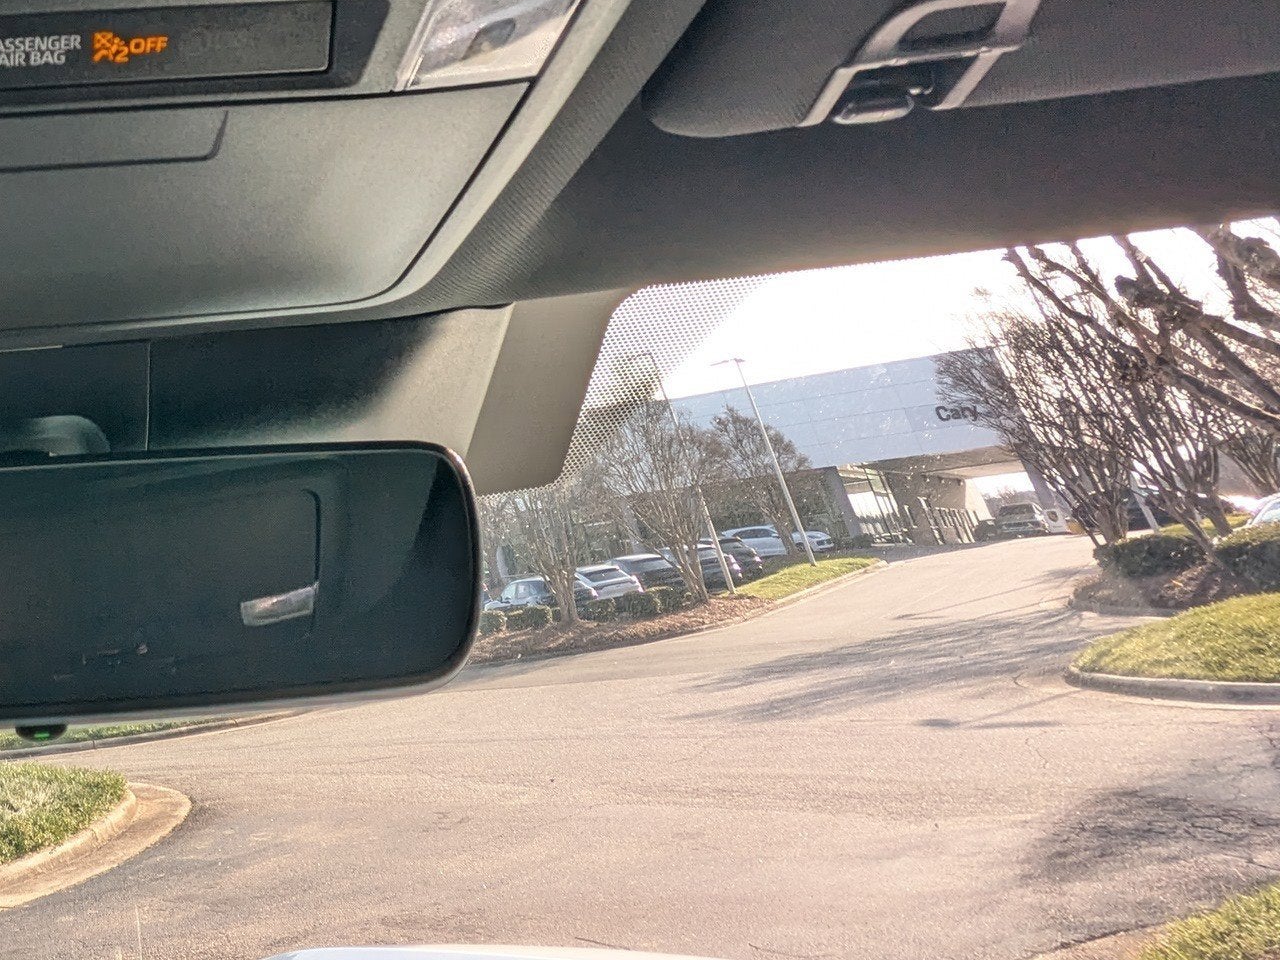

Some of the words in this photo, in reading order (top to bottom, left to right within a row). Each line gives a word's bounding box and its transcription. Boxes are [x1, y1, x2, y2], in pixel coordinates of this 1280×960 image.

[129, 36, 168, 55] OFF
[29, 50, 66, 66] BAG
[935, 404, 979, 422] Cary
